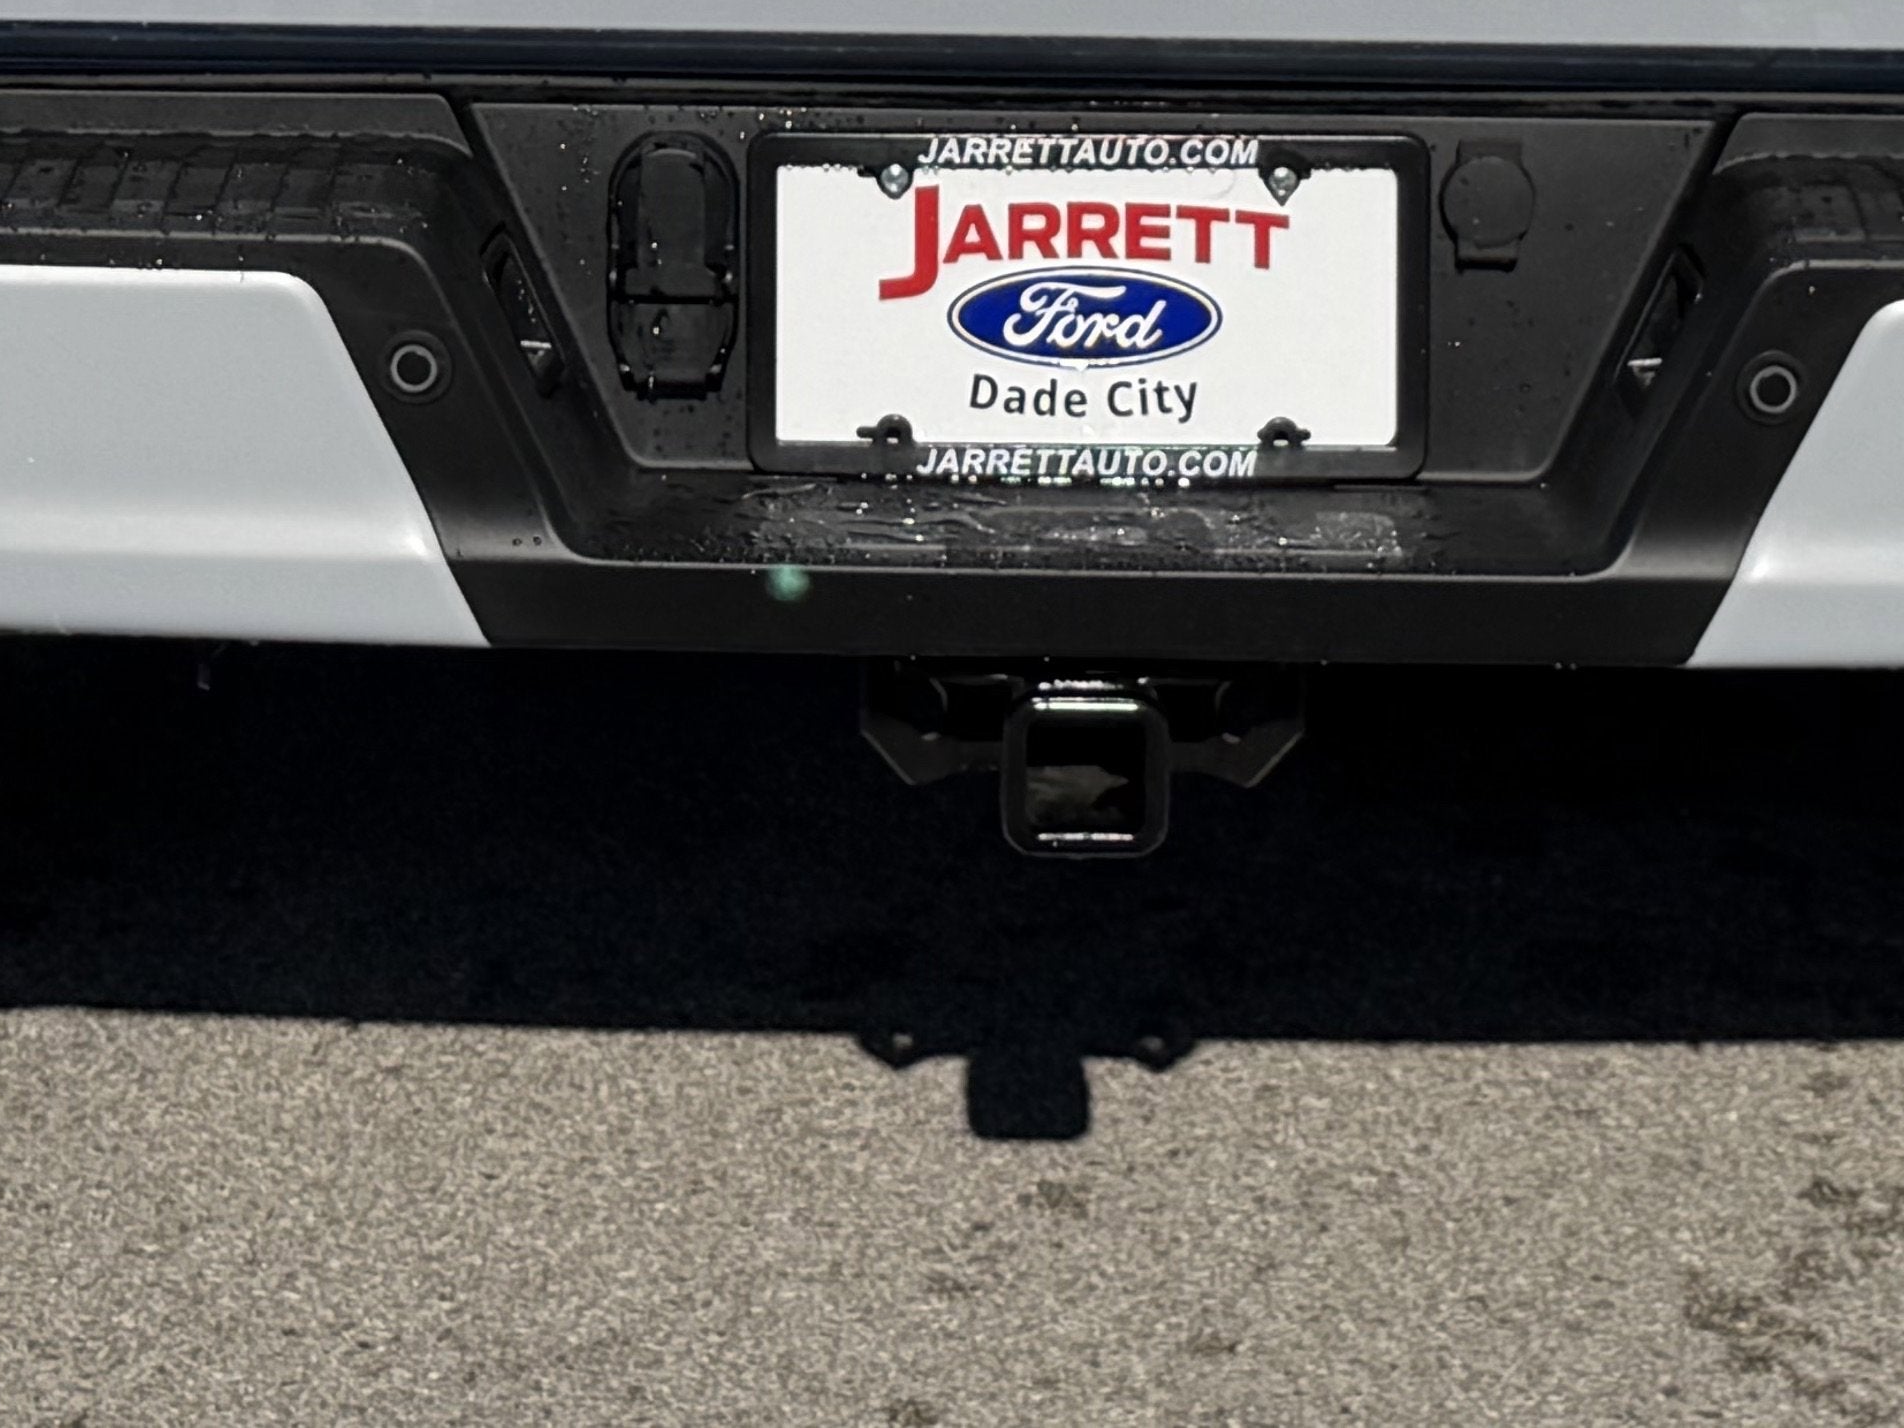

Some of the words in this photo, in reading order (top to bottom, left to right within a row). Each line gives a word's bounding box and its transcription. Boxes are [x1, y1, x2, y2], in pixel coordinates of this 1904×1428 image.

[917, 137, 1259, 167] JARRETTAUTO.COM
[878, 184, 1291, 302] JARRETT
[1002, 281, 1167, 349] Ford
[969, 373, 1089, 419] Dade
[1106, 377, 1198, 424] City
[916, 446, 1257, 479] JARRETTAUTO.COM
